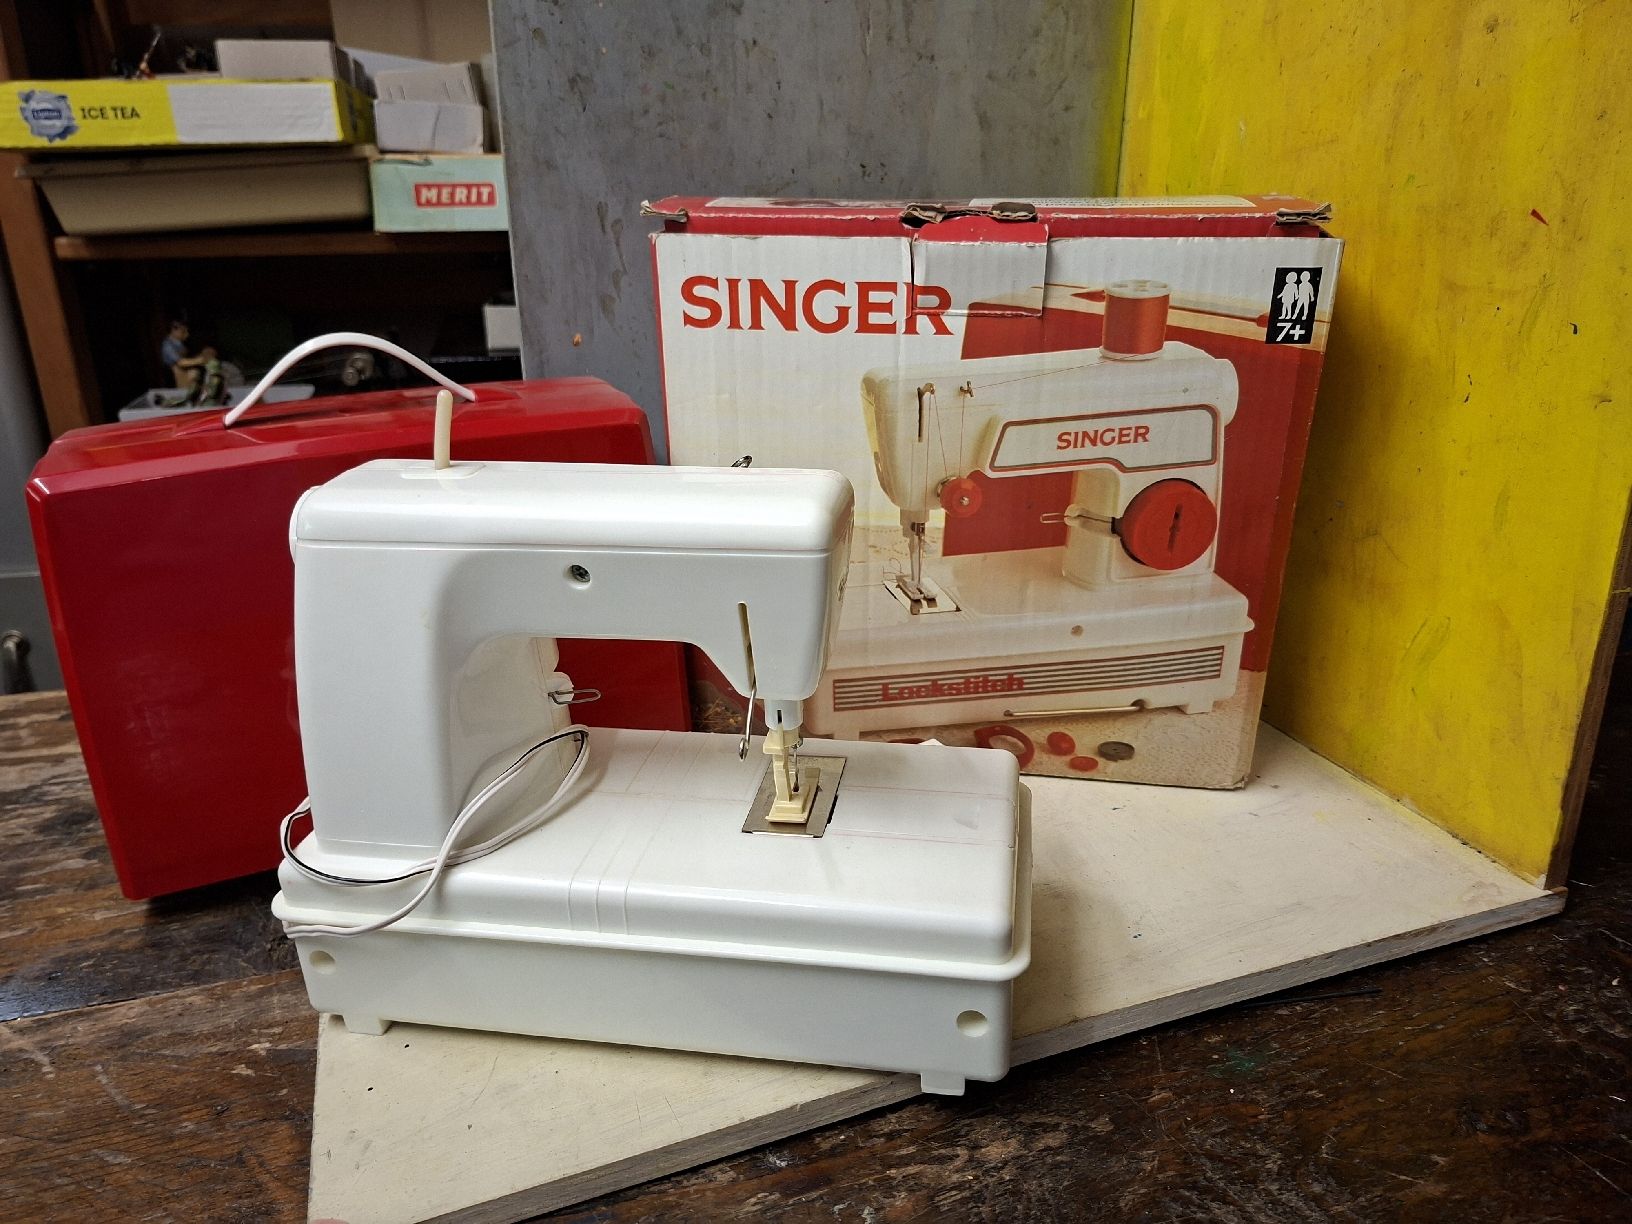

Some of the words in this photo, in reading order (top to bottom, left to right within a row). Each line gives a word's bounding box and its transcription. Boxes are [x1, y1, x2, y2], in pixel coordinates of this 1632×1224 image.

[80, 106, 108, 119] ICE
[110, 106, 140, 119] TEA
[420, 185, 492, 204] MERIT
[680, 275, 954, 336] SINGER
[1275, 322, 1306, 342] 7+
[1056, 425, 1150, 450] SINGER
[881, 672, 1025, 701] Lockstitch
